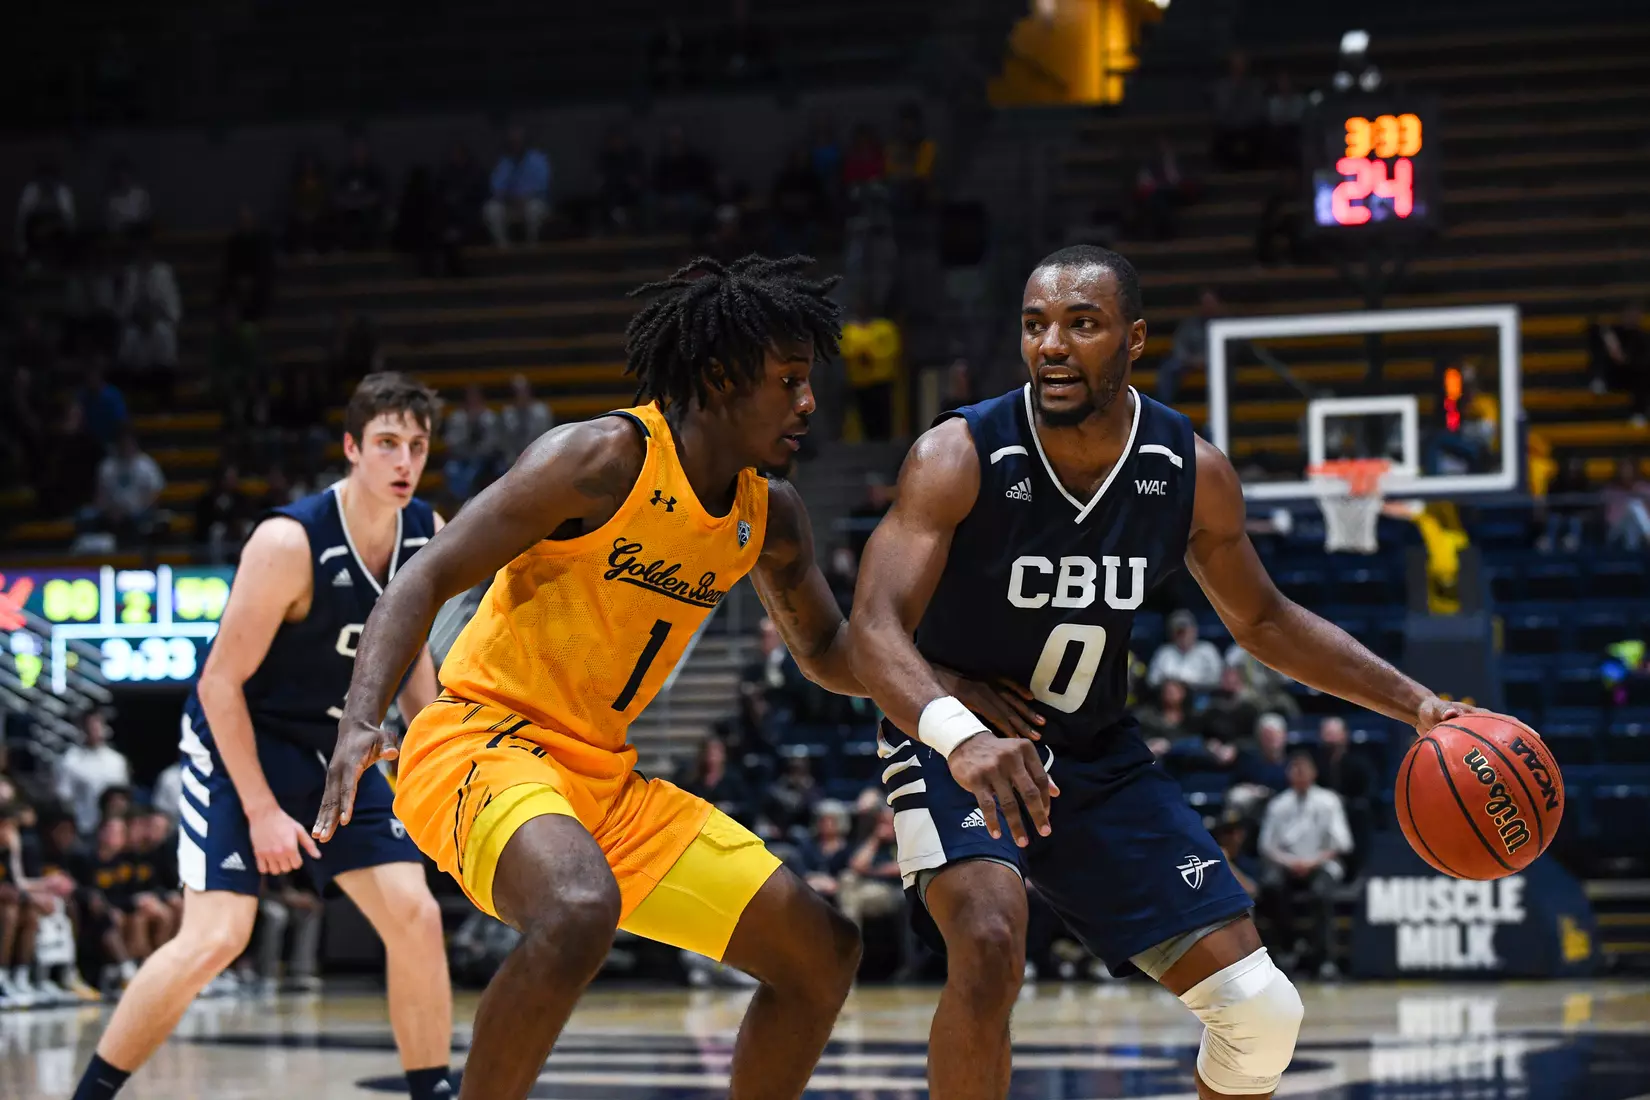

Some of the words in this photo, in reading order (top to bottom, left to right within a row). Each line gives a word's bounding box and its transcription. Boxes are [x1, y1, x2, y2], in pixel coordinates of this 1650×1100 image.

[1332, 157, 1413, 225] 24
[1005, 490, 1032, 502] adida
[1134, 480, 1167, 495] WAC
[604, 537, 689, 595] Golden
[690, 571, 728, 602] Bea
[1007, 556, 1147, 609] CBU
[611, 619, 672, 711] 1
[1029, 623, 1106, 714] 0
[1463, 747, 1531, 855] Wilson
[1510, 736, 1559, 812] NCAA
[961, 819, 986, 828] adid
[1367, 875, 1526, 923] MUSCLE
[1398, 922, 1497, 970] MILK
